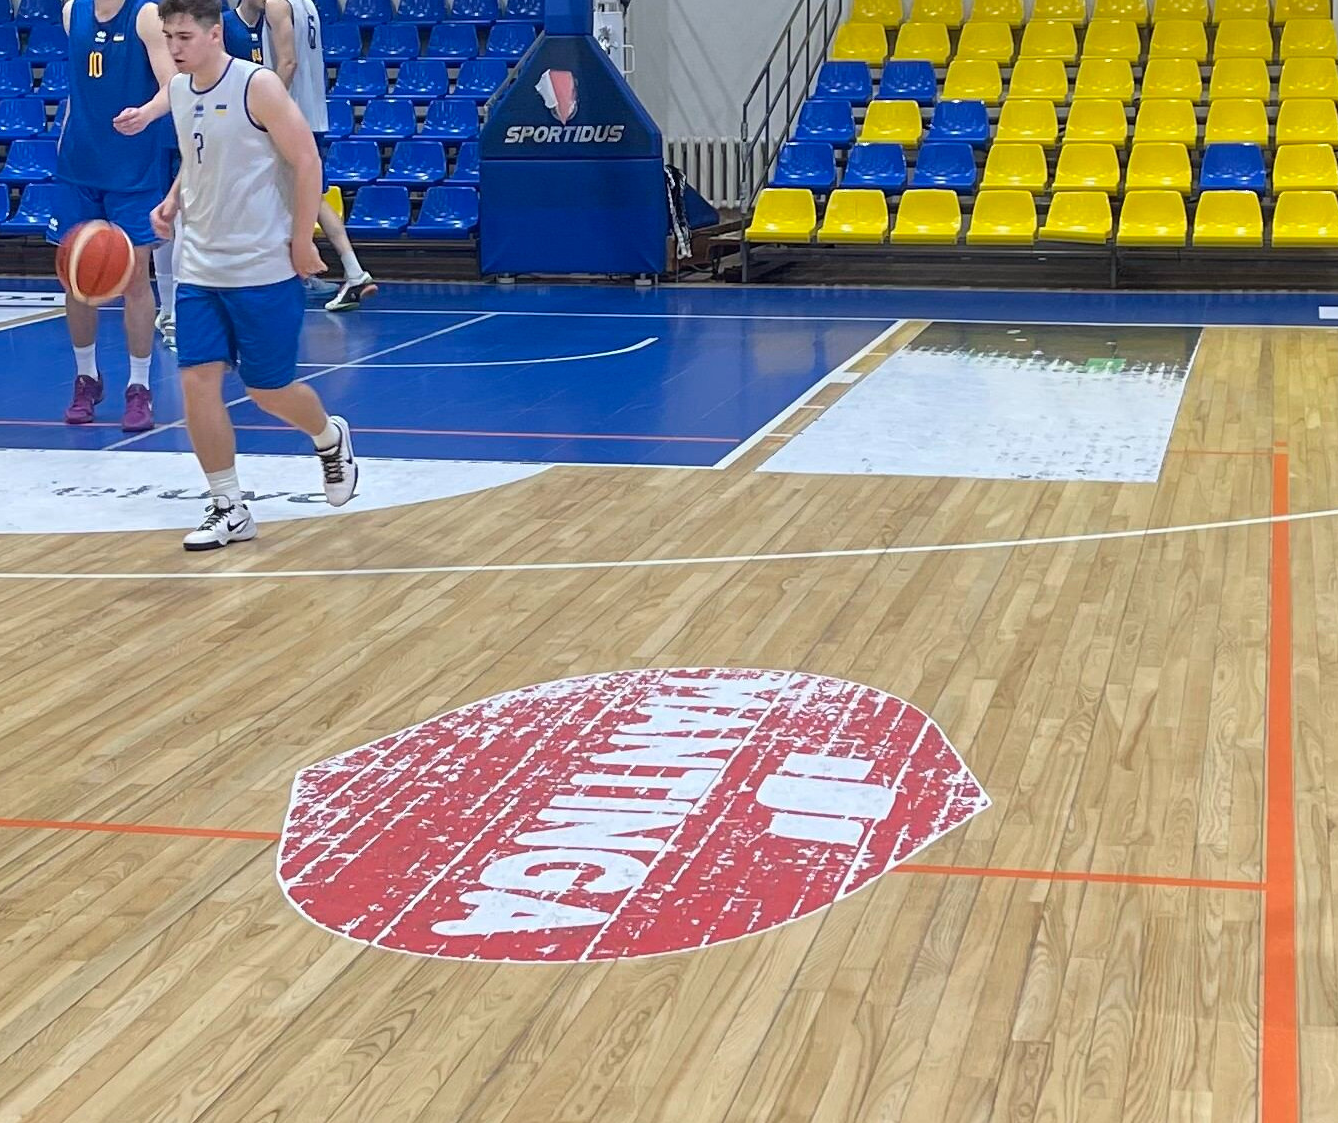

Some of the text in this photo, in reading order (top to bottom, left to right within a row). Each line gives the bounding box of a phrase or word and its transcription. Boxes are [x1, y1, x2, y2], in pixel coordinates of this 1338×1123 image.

[307, 15, 317, 50] 6
[88, 51, 103, 78] 10
[504, 125, 625, 144] SPORTIDUS
[430, 676, 784, 937] MANTINGA
